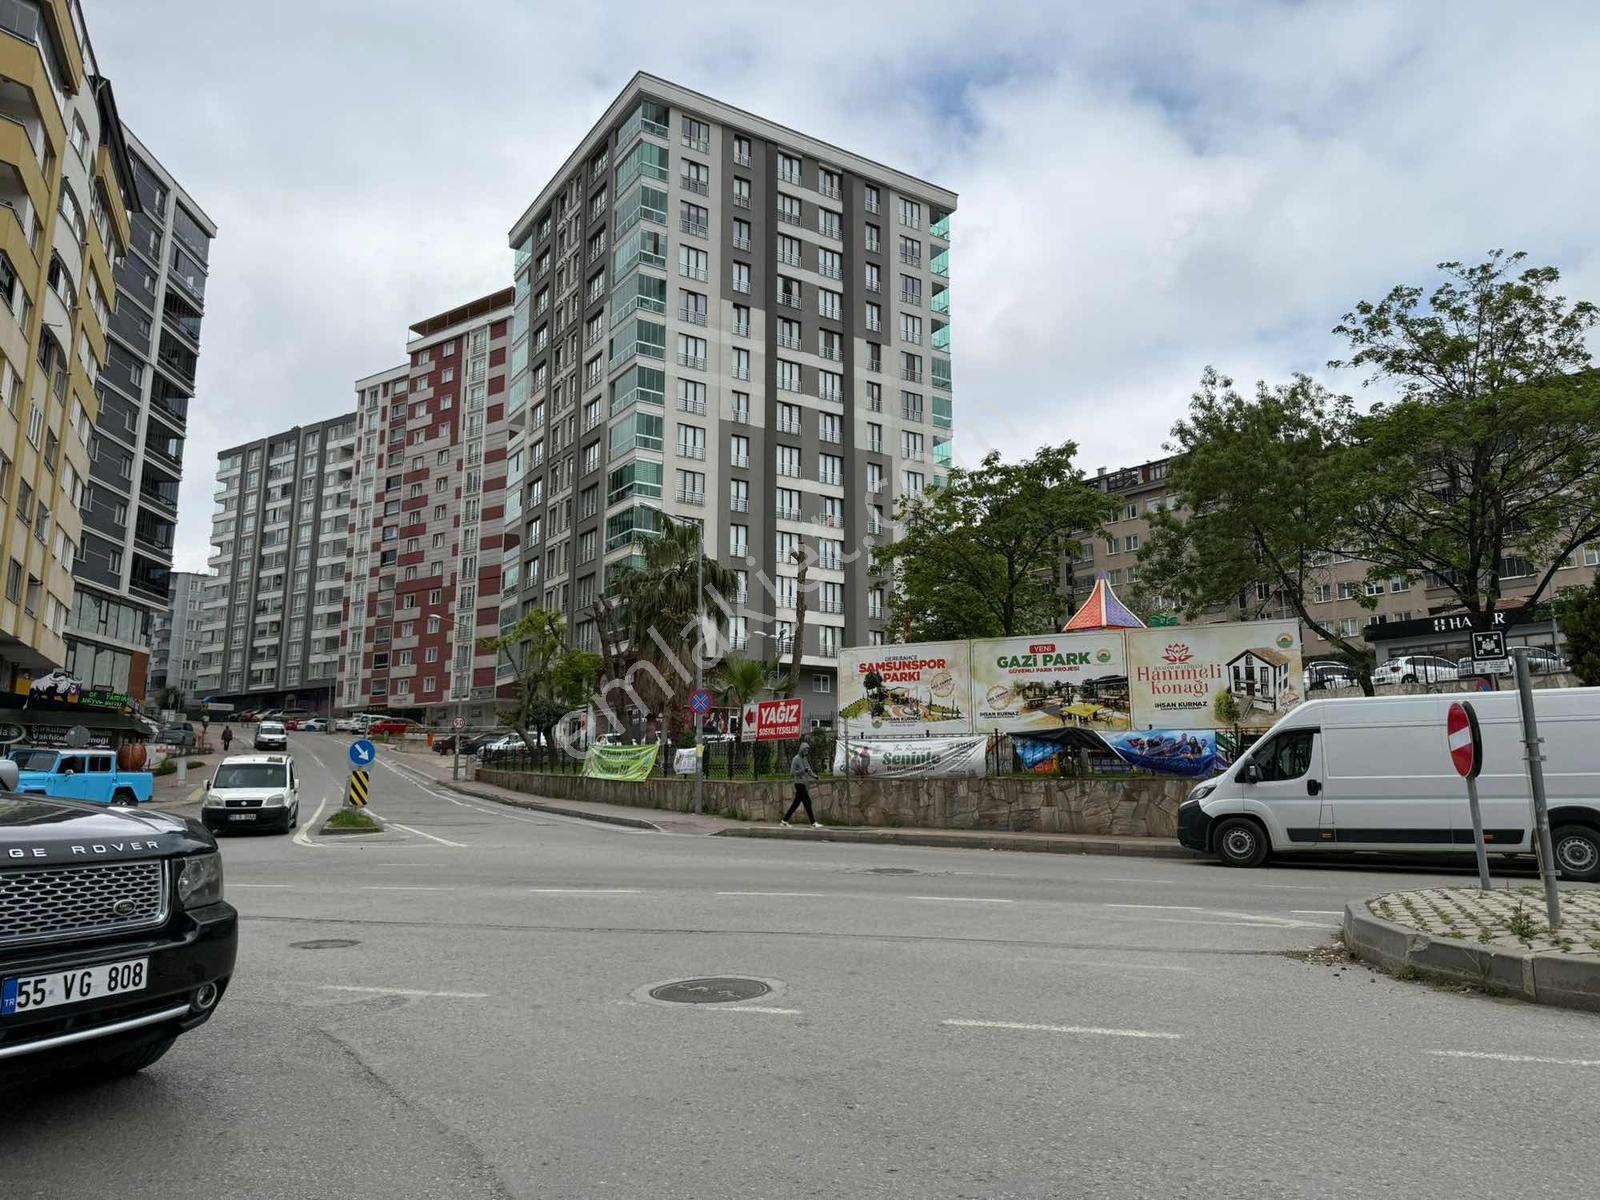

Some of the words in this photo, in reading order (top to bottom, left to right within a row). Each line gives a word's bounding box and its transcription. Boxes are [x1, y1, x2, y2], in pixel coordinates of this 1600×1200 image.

[1449, 612, 1506, 629] HAR
[859, 659, 946, 673] SAMSUNSPOR
[997, 654, 1037, 668] GAZİ
[1042, 652, 1091, 666] PARK
[883, 672, 920, 682] PARKI
[1137, 664, 1221, 681] Hanımeli
[761, 701, 799, 725] YAĞIZ
[72, 841, 159, 854] ROVER
[17, 978, 47, 1008] 55
[63, 971, 92, 1000] VG
[107, 962, 144, 992] 808
[5, 999, 15, 1007] TR
